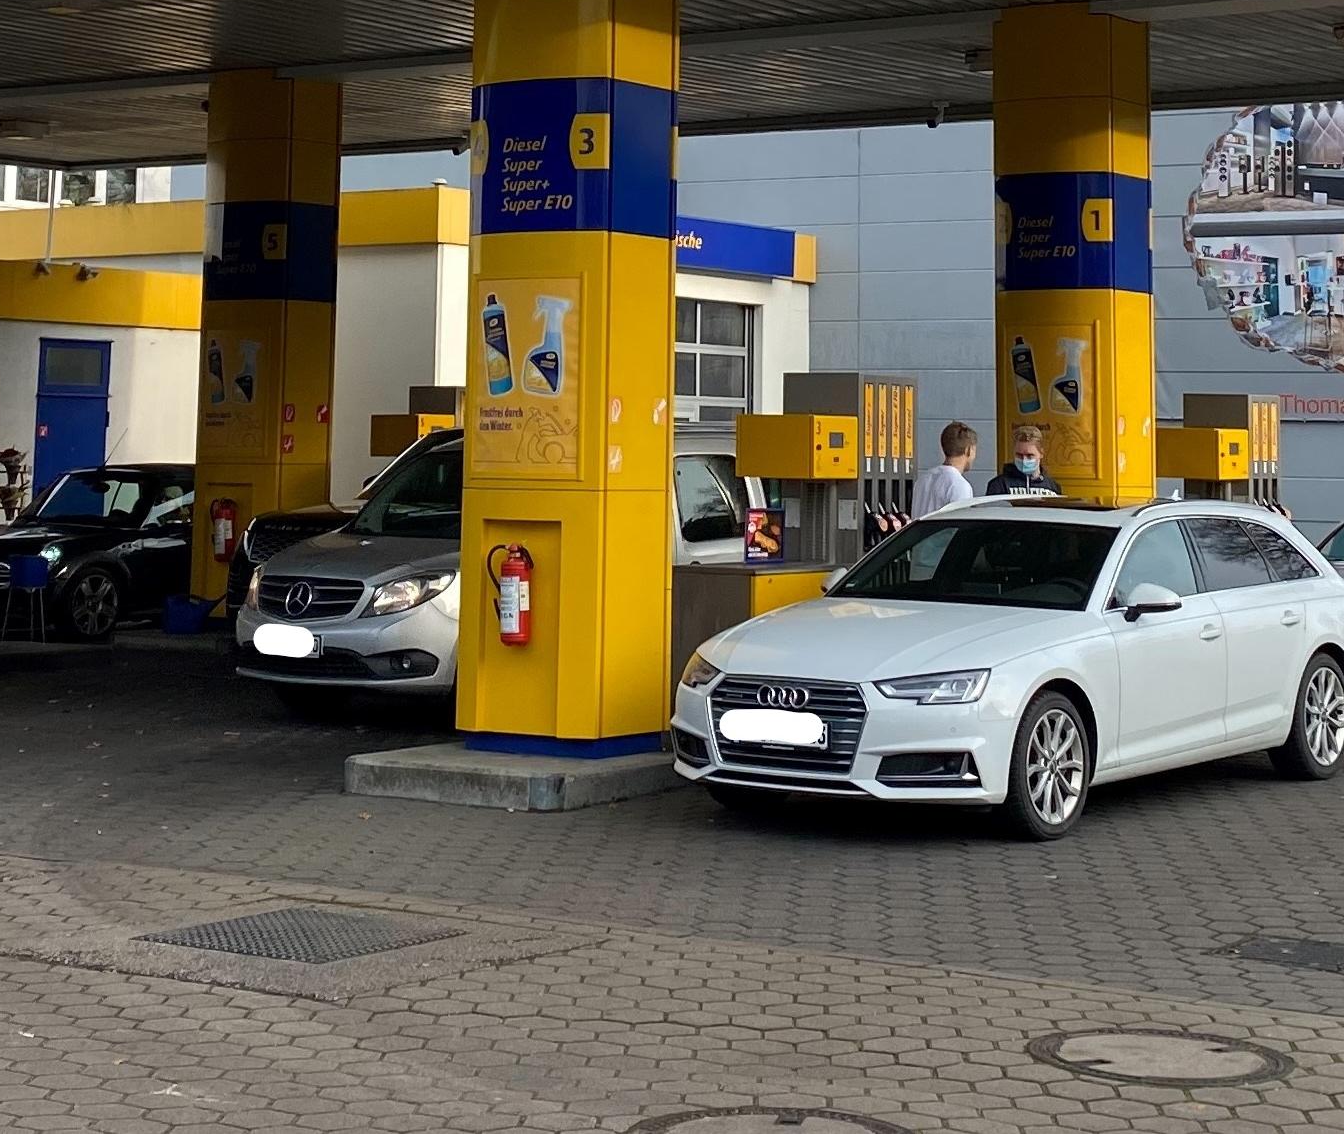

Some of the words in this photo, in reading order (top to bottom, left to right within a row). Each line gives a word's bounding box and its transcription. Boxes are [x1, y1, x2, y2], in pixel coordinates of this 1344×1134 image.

[503, 135, 548, 153] Diesel
[578, 127, 595, 155] 3
[502, 158, 543, 176] Super
[501, 197, 542, 216] Super
[544, 194, 573, 210] E10
[1017, 215, 1054, 229] Diesel
[1089, 209, 1101, 232] 1
[266, 232, 279, 252] 5
[1018, 231, 1051, 246] Super
[1018, 247, 1051, 262] Super
[1053, 245, 1076, 257] E10
